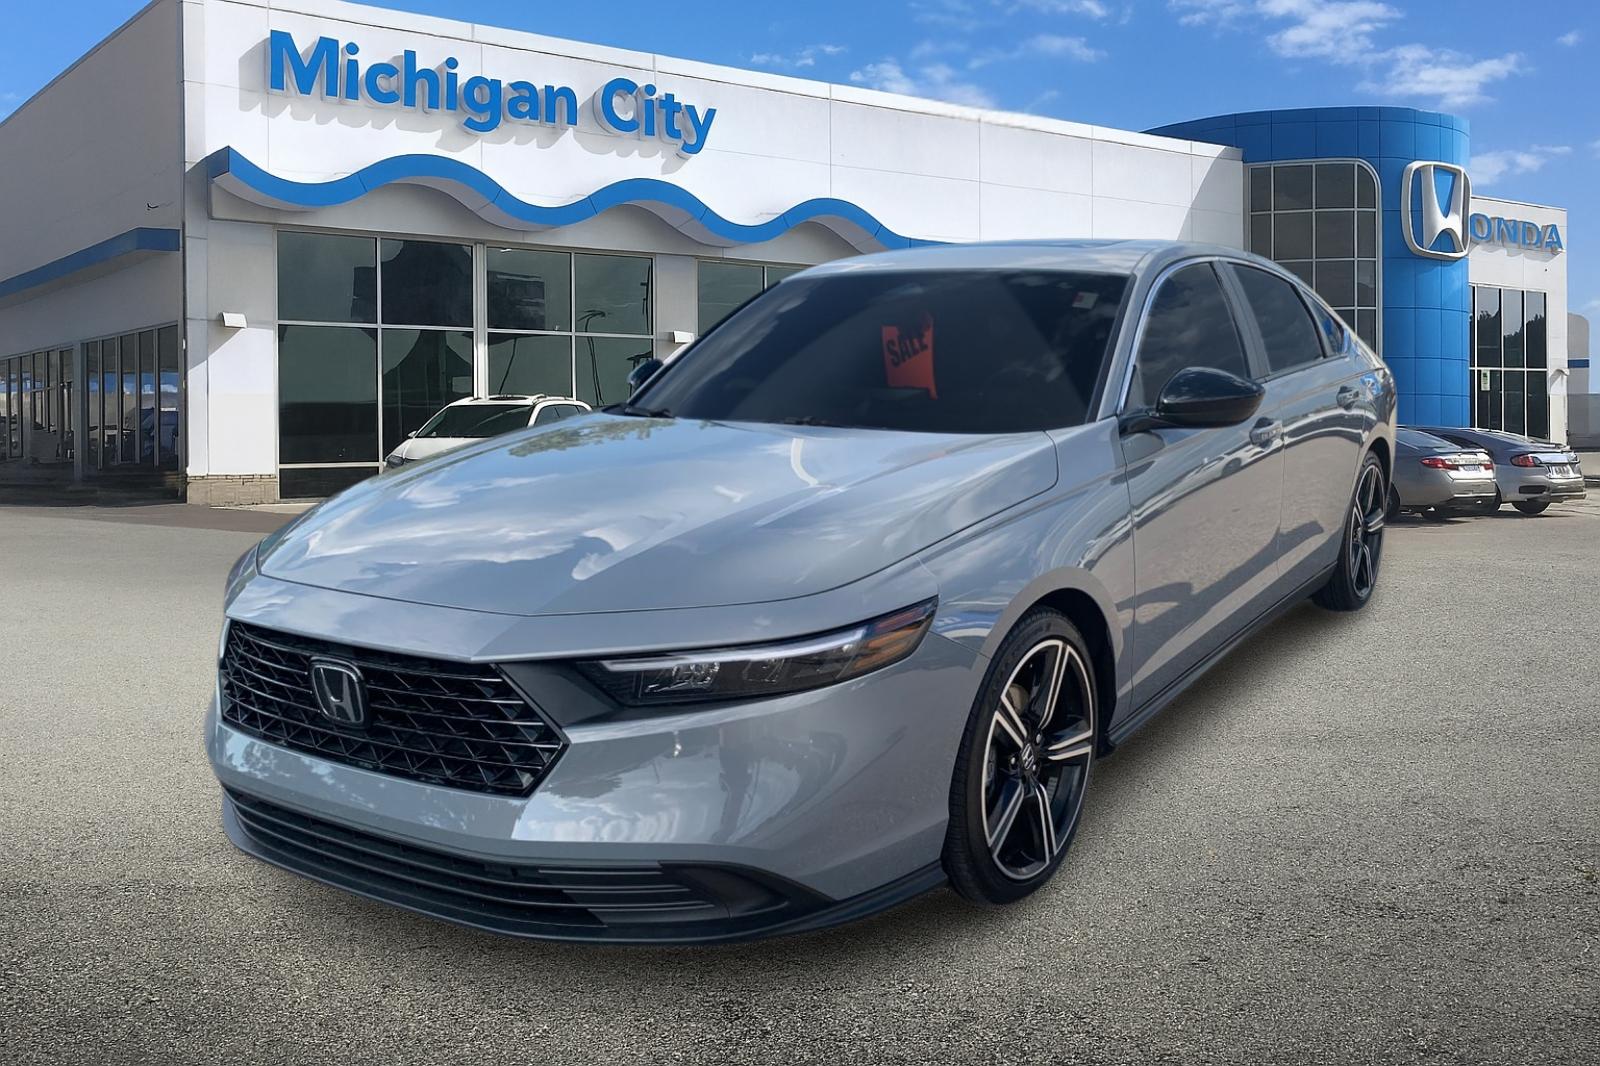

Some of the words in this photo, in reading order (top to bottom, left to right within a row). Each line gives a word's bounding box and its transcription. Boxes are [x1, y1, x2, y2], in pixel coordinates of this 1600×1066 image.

[268, 29, 578, 134] Michigan
[600, 76, 718, 155] City
[1469, 213, 1564, 250] ONDA
[886, 331, 929, 368] SALE
